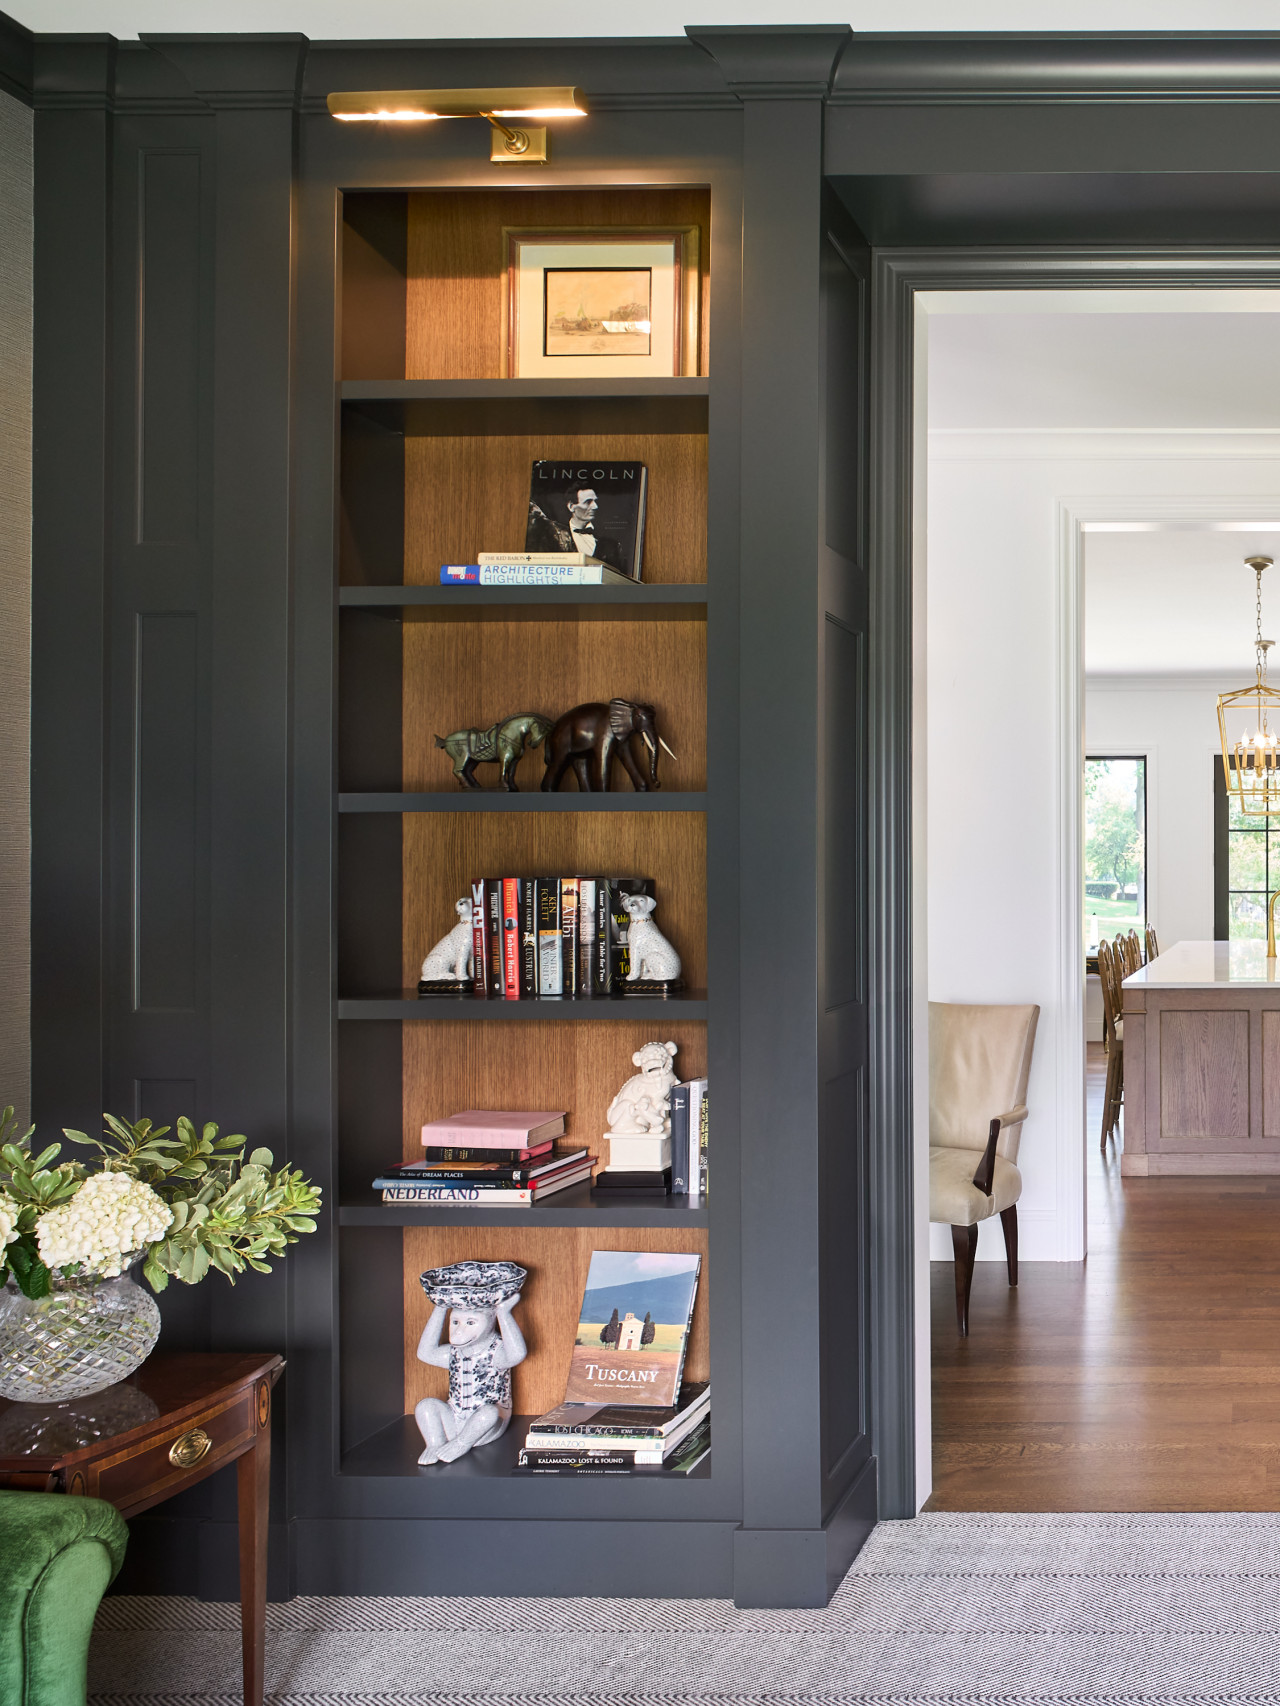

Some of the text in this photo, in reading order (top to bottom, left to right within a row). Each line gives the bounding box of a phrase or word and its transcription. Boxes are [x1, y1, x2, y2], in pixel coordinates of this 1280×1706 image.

[539, 469, 634, 480] LINCOLN
[485, 565, 574, 575] ARCHITECTURE
[541, 888, 549, 921] FOLLETT
[549, 896, 557, 913] KEN
[562, 904, 575, 938] Alibi
[506, 882, 515, 983] Munich Robert Harris
[525, 947, 533, 980] LUSTRUM
[542, 948, 550, 981] WORLD
[384, 1189, 479, 1200] NEDERLAND
[584, 1364, 660, 1383] TUSCANY
[555, 1425, 574, 1435] LOST
[574, 1425, 614, 1435] CHICAGO
[530, 1440, 586, 1448] KALAMAZOO
